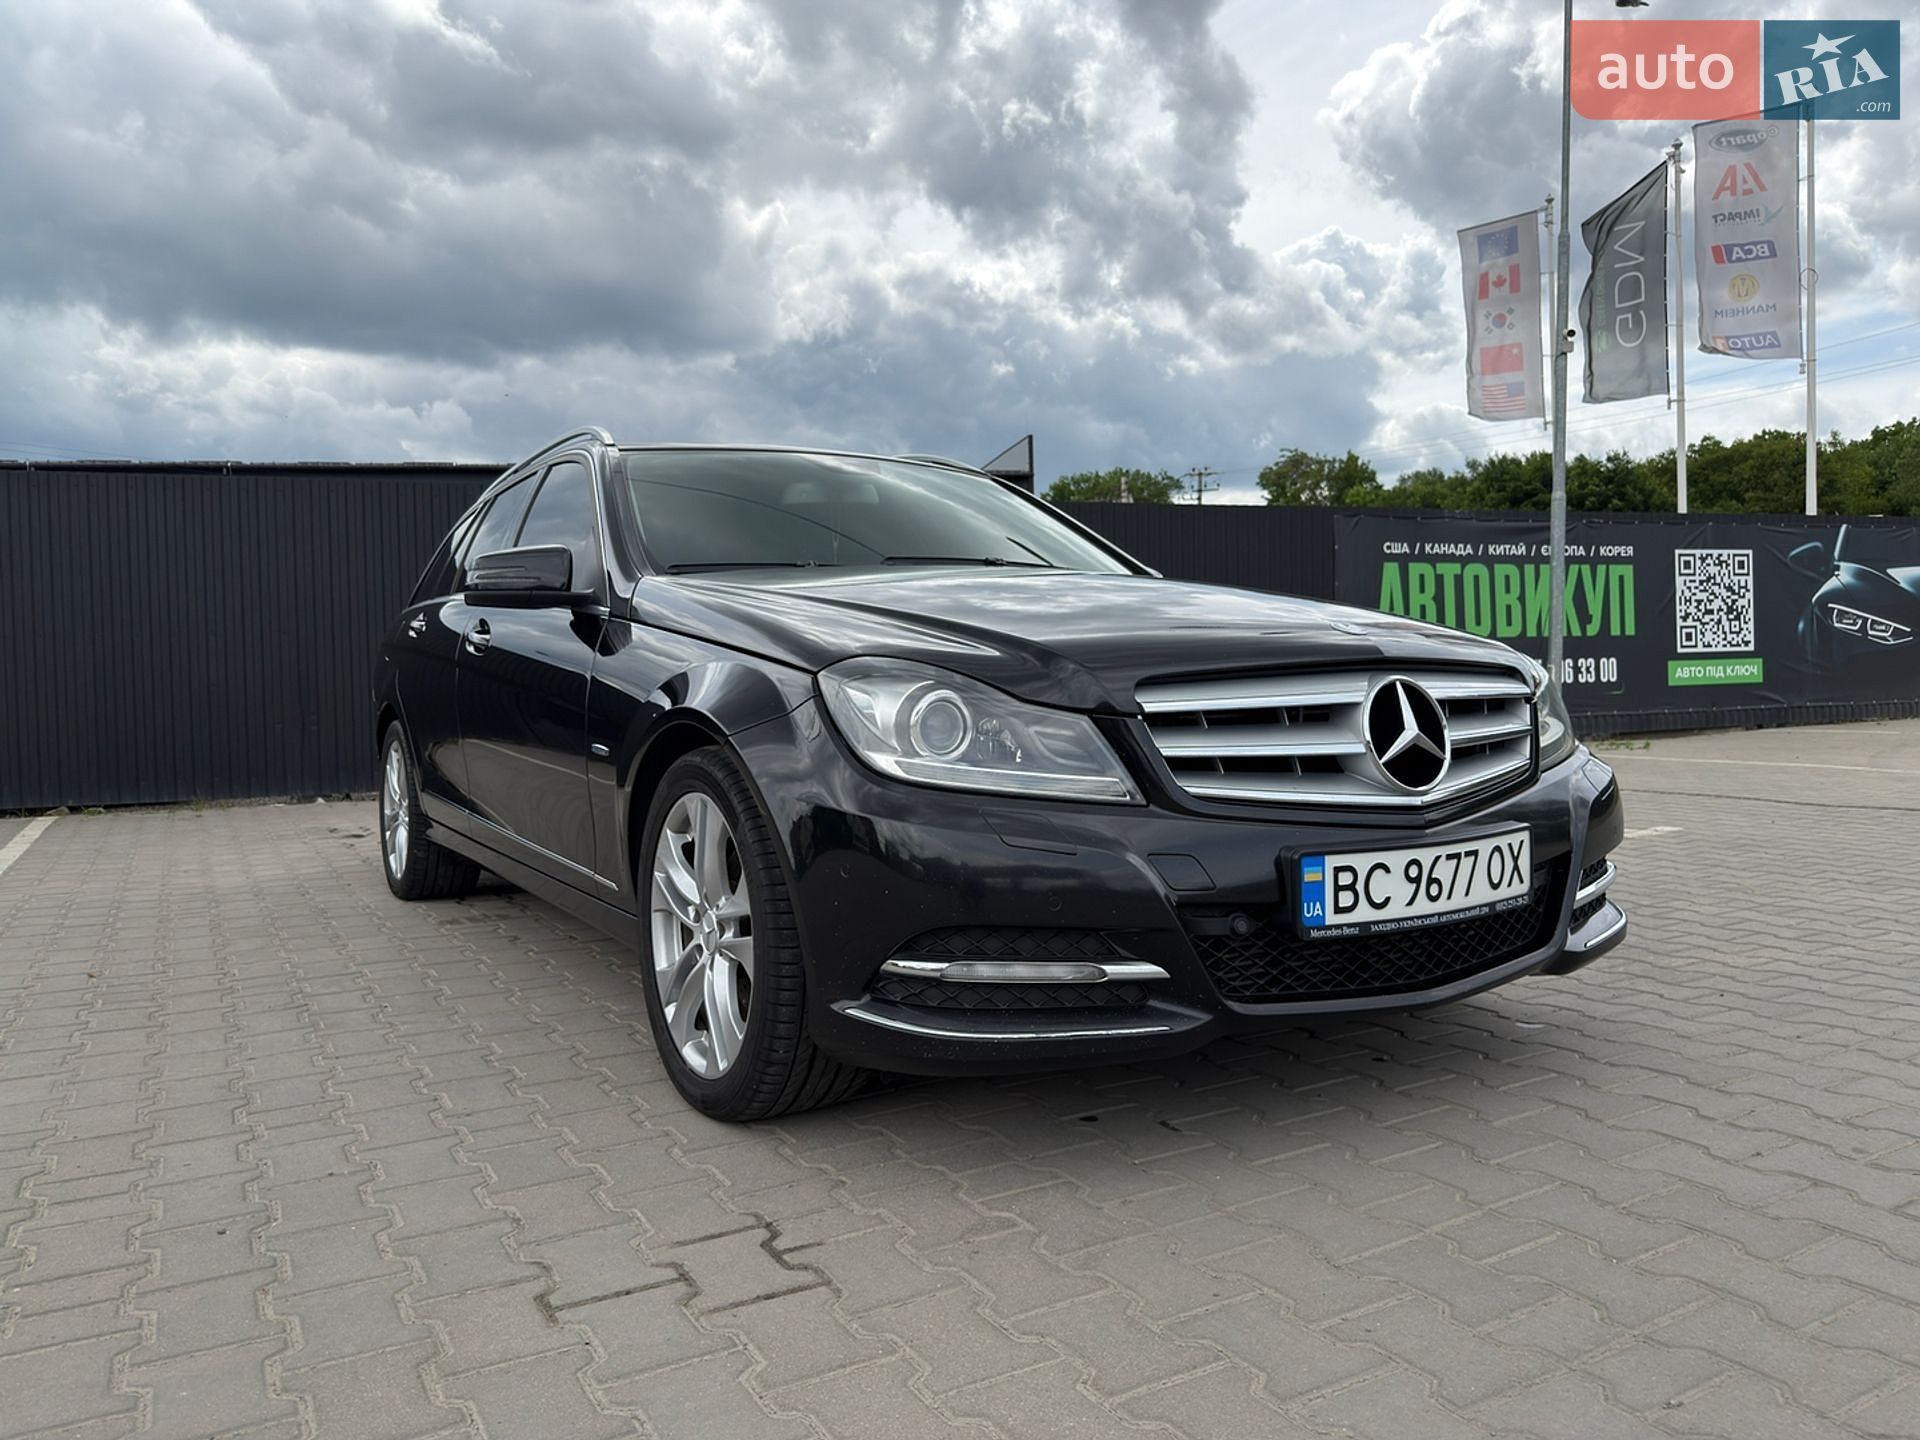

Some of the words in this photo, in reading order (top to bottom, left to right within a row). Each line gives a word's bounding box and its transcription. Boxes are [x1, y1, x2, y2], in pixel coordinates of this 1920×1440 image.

[1383, 542, 1410, 554] США
[1425, 543, 1473, 556] КАНАДА
[1488, 543, 1526, 556] КИТАЙ
[1541, 545, 1586, 557] ЄОПА
[1600, 546, 1634, 557] КОРЕЯ
[1379, 562, 1636, 638] АВТОВИКУП
[1578, 658, 1595, 683] 33
[1600, 657, 1617, 682] 00
[1675, 666, 1704, 678] АВТО
[1706, 665, 1725, 678] ПІД
[1726, 664, 1758, 676] КЛЮЧ
[1333, 862, 1391, 915] BC
[1404, 849, 1479, 907] 9677
[1487, 839, 1524, 890] OX
[1304, 901, 1323, 917] UA
